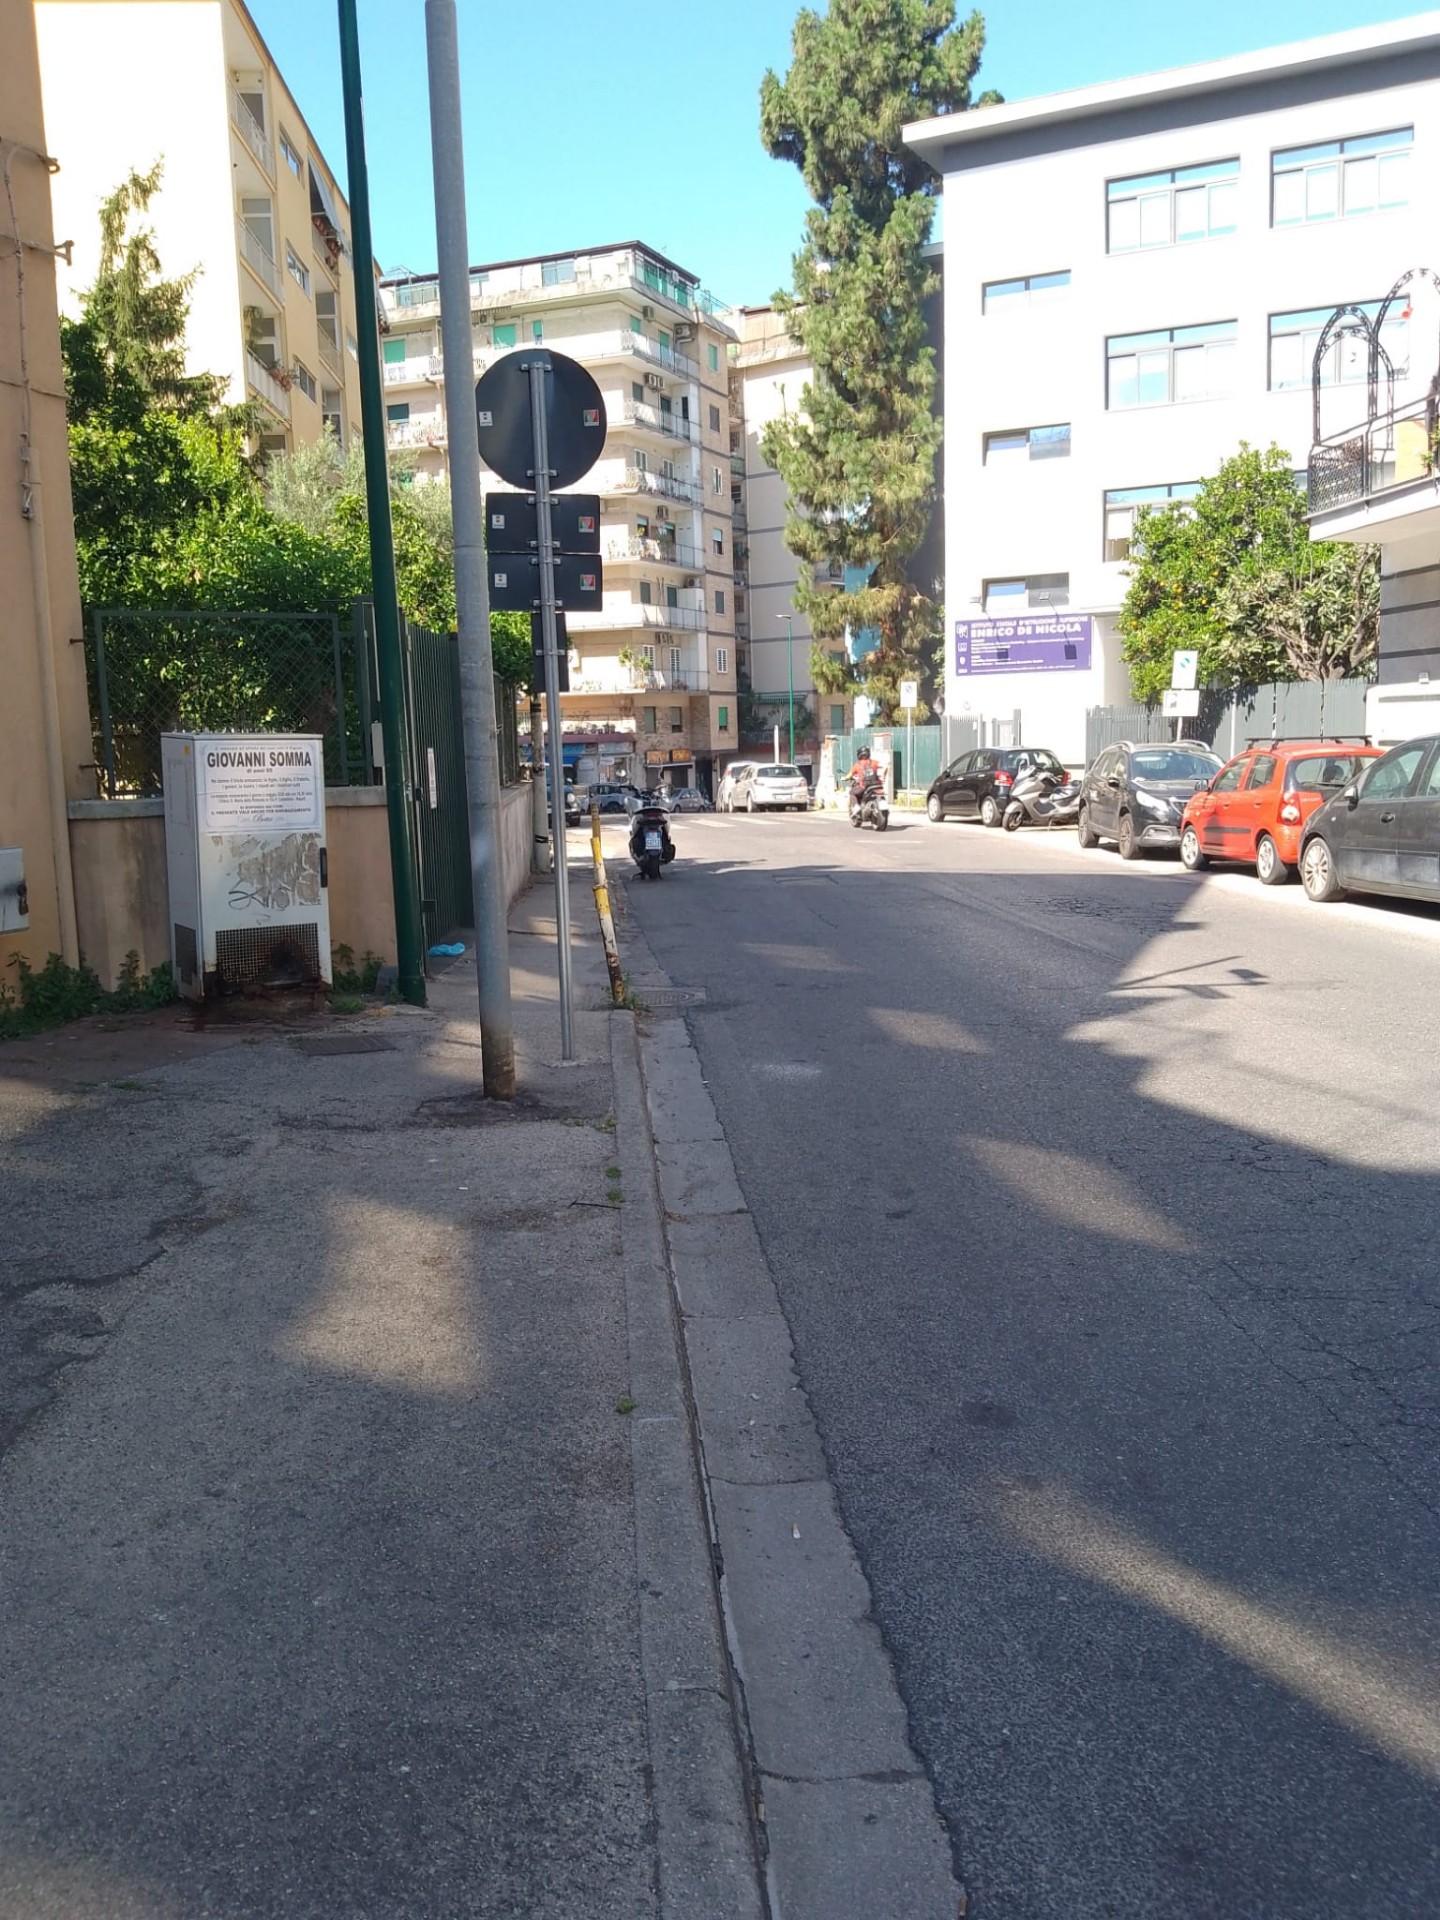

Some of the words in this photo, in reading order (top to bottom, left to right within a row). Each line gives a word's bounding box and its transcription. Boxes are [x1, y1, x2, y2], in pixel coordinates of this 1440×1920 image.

[971, 627, 1015, 638] ENRICO
[1017, 626, 1032, 635] DE
[1036, 622, 1082, 634] NICOLA
[207, 752, 266, 768] GIOVANNI
[269, 751, 312, 767] SOMMA
